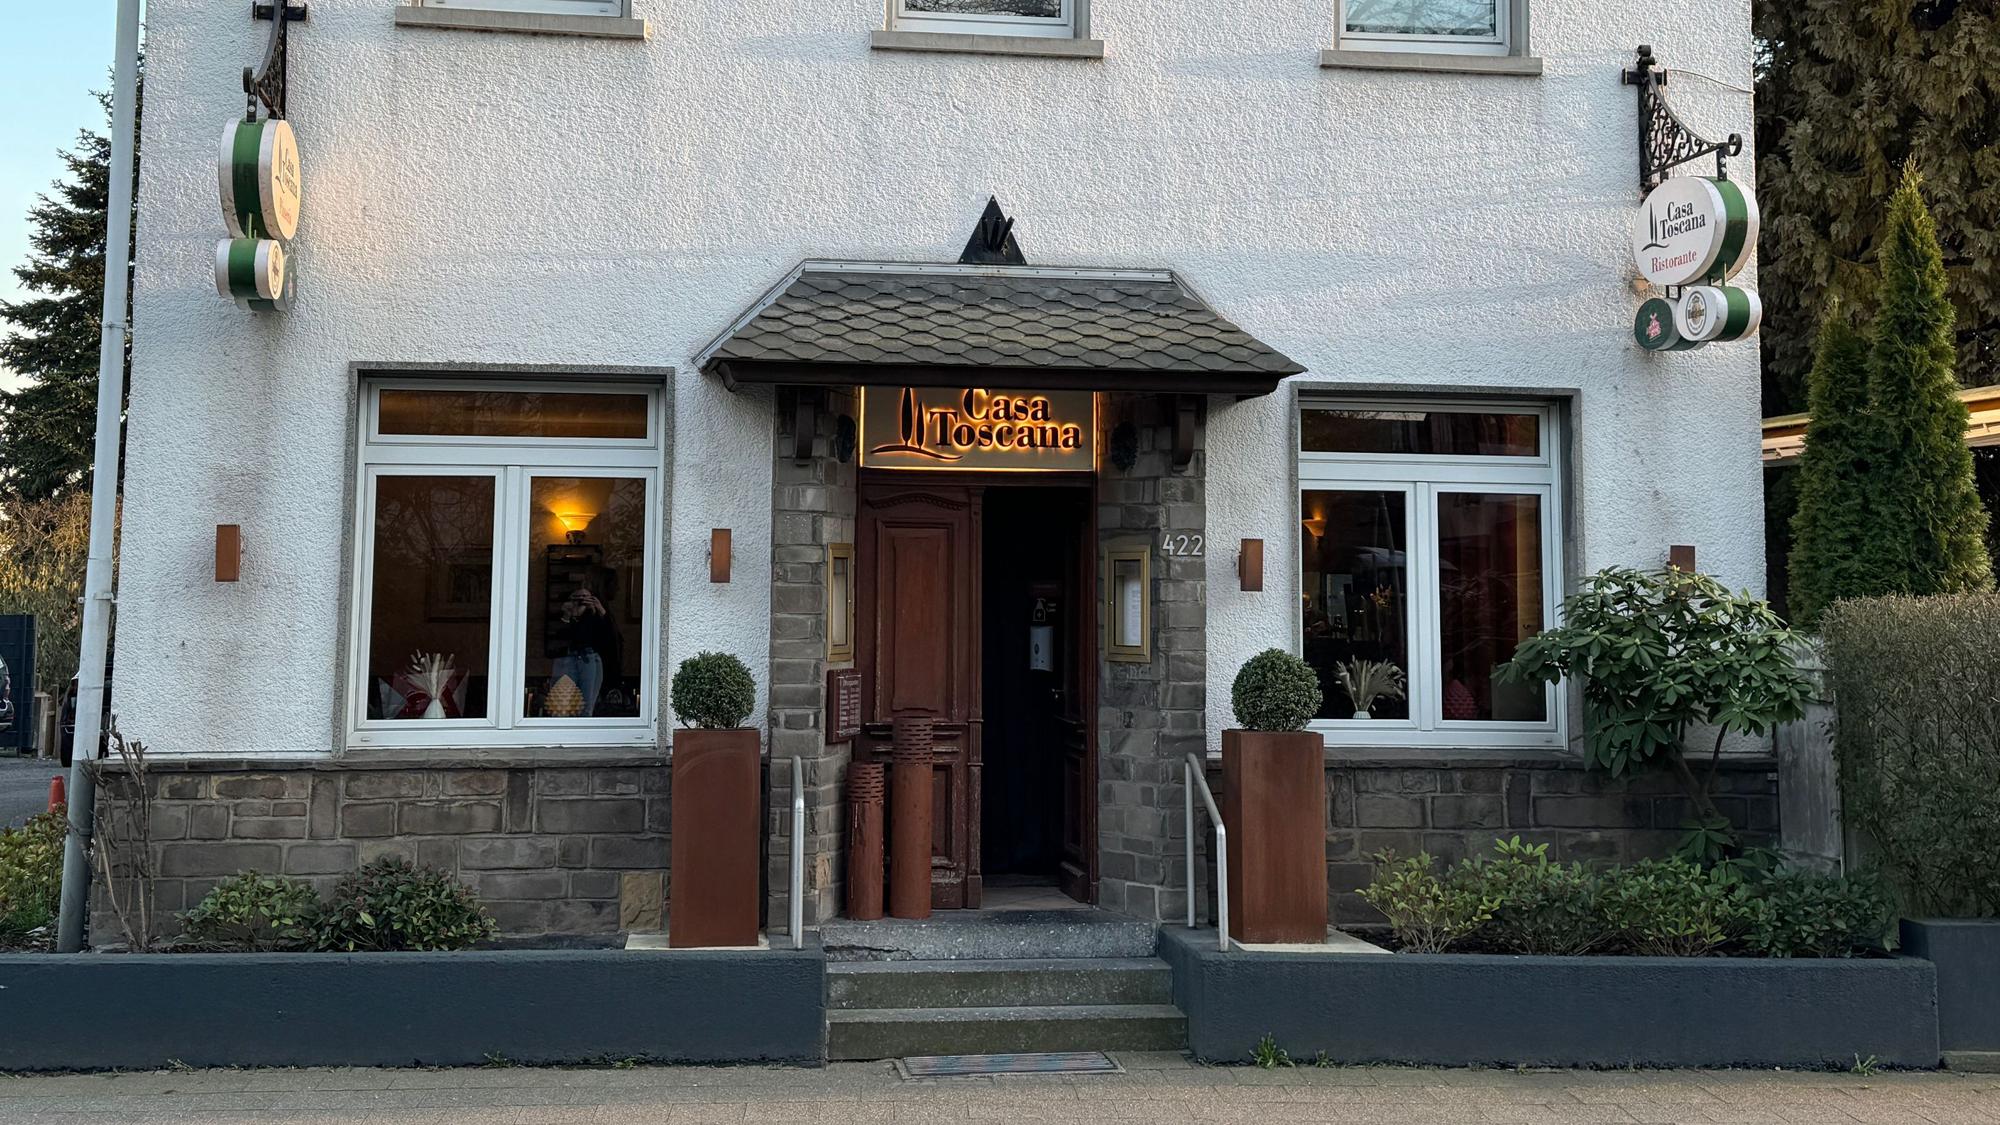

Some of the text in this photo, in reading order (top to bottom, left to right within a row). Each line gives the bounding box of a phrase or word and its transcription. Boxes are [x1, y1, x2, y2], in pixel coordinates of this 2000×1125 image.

[1667, 201, 1693, 222] Casa
[1660, 213, 1706, 240] Toscana
[1651, 250, 1697, 273] Ristorante
[963, 388, 1051, 421] Casa
[929, 410, 1082, 448] Toscana
[1162, 534, 1203, 556] 422
